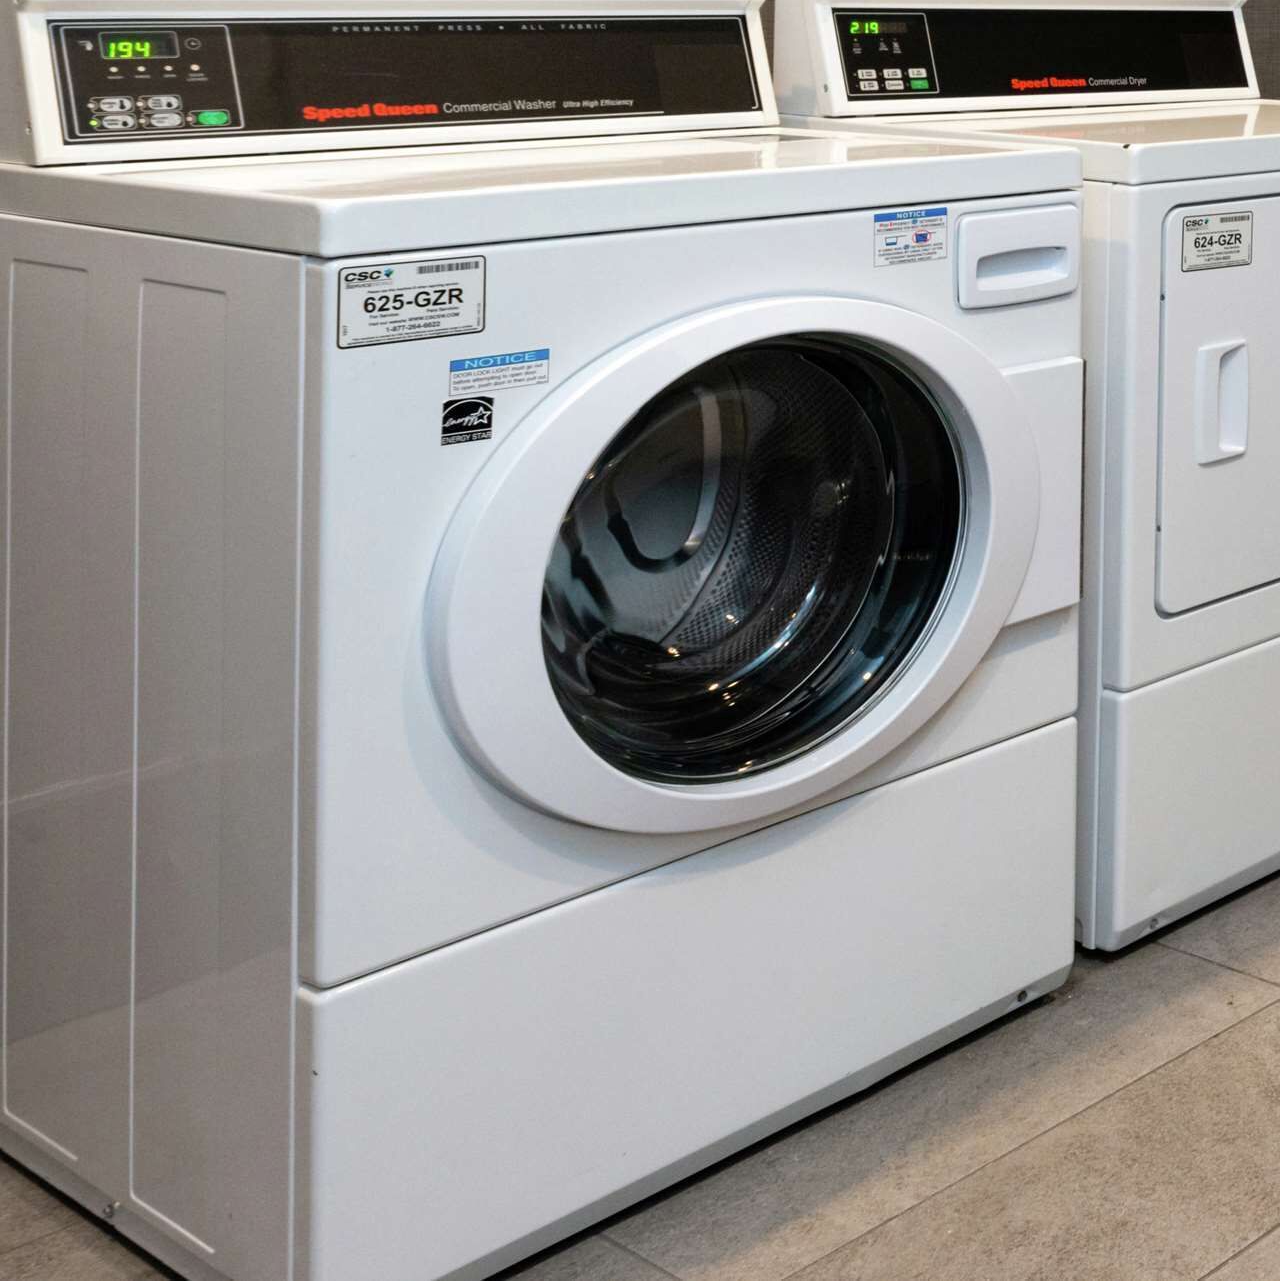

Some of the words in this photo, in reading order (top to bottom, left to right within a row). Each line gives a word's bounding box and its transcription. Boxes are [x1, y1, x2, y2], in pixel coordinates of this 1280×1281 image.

[850, 22, 879, 34] 219
[108, 41, 151, 59] 194
[1011, 78, 1049, 91] Speed
[1049, 76, 1087, 87] Queen
[1088, 76, 1128, 87] Commercial
[1128, 76, 1147, 87] Dryer
[582, 99, 599, 108] High
[600, 98, 634, 107] Efficiency
[303, 104, 371, 122] Speed
[373, 102, 439, 117] Queen
[443, 101, 512, 114] Commercial
[513, 99, 557, 111] Washer
[896, 210, 926, 219] NOTICE
[1185, 219, 1204, 228] CSC
[1194, 233, 1242, 249] 624-GZR
[344, 270, 382, 282] CSC
[363, 288, 464, 313] 625-GZR
[464, 351, 537, 369] NOTICE
[441, 434, 471, 444] ENERGY
